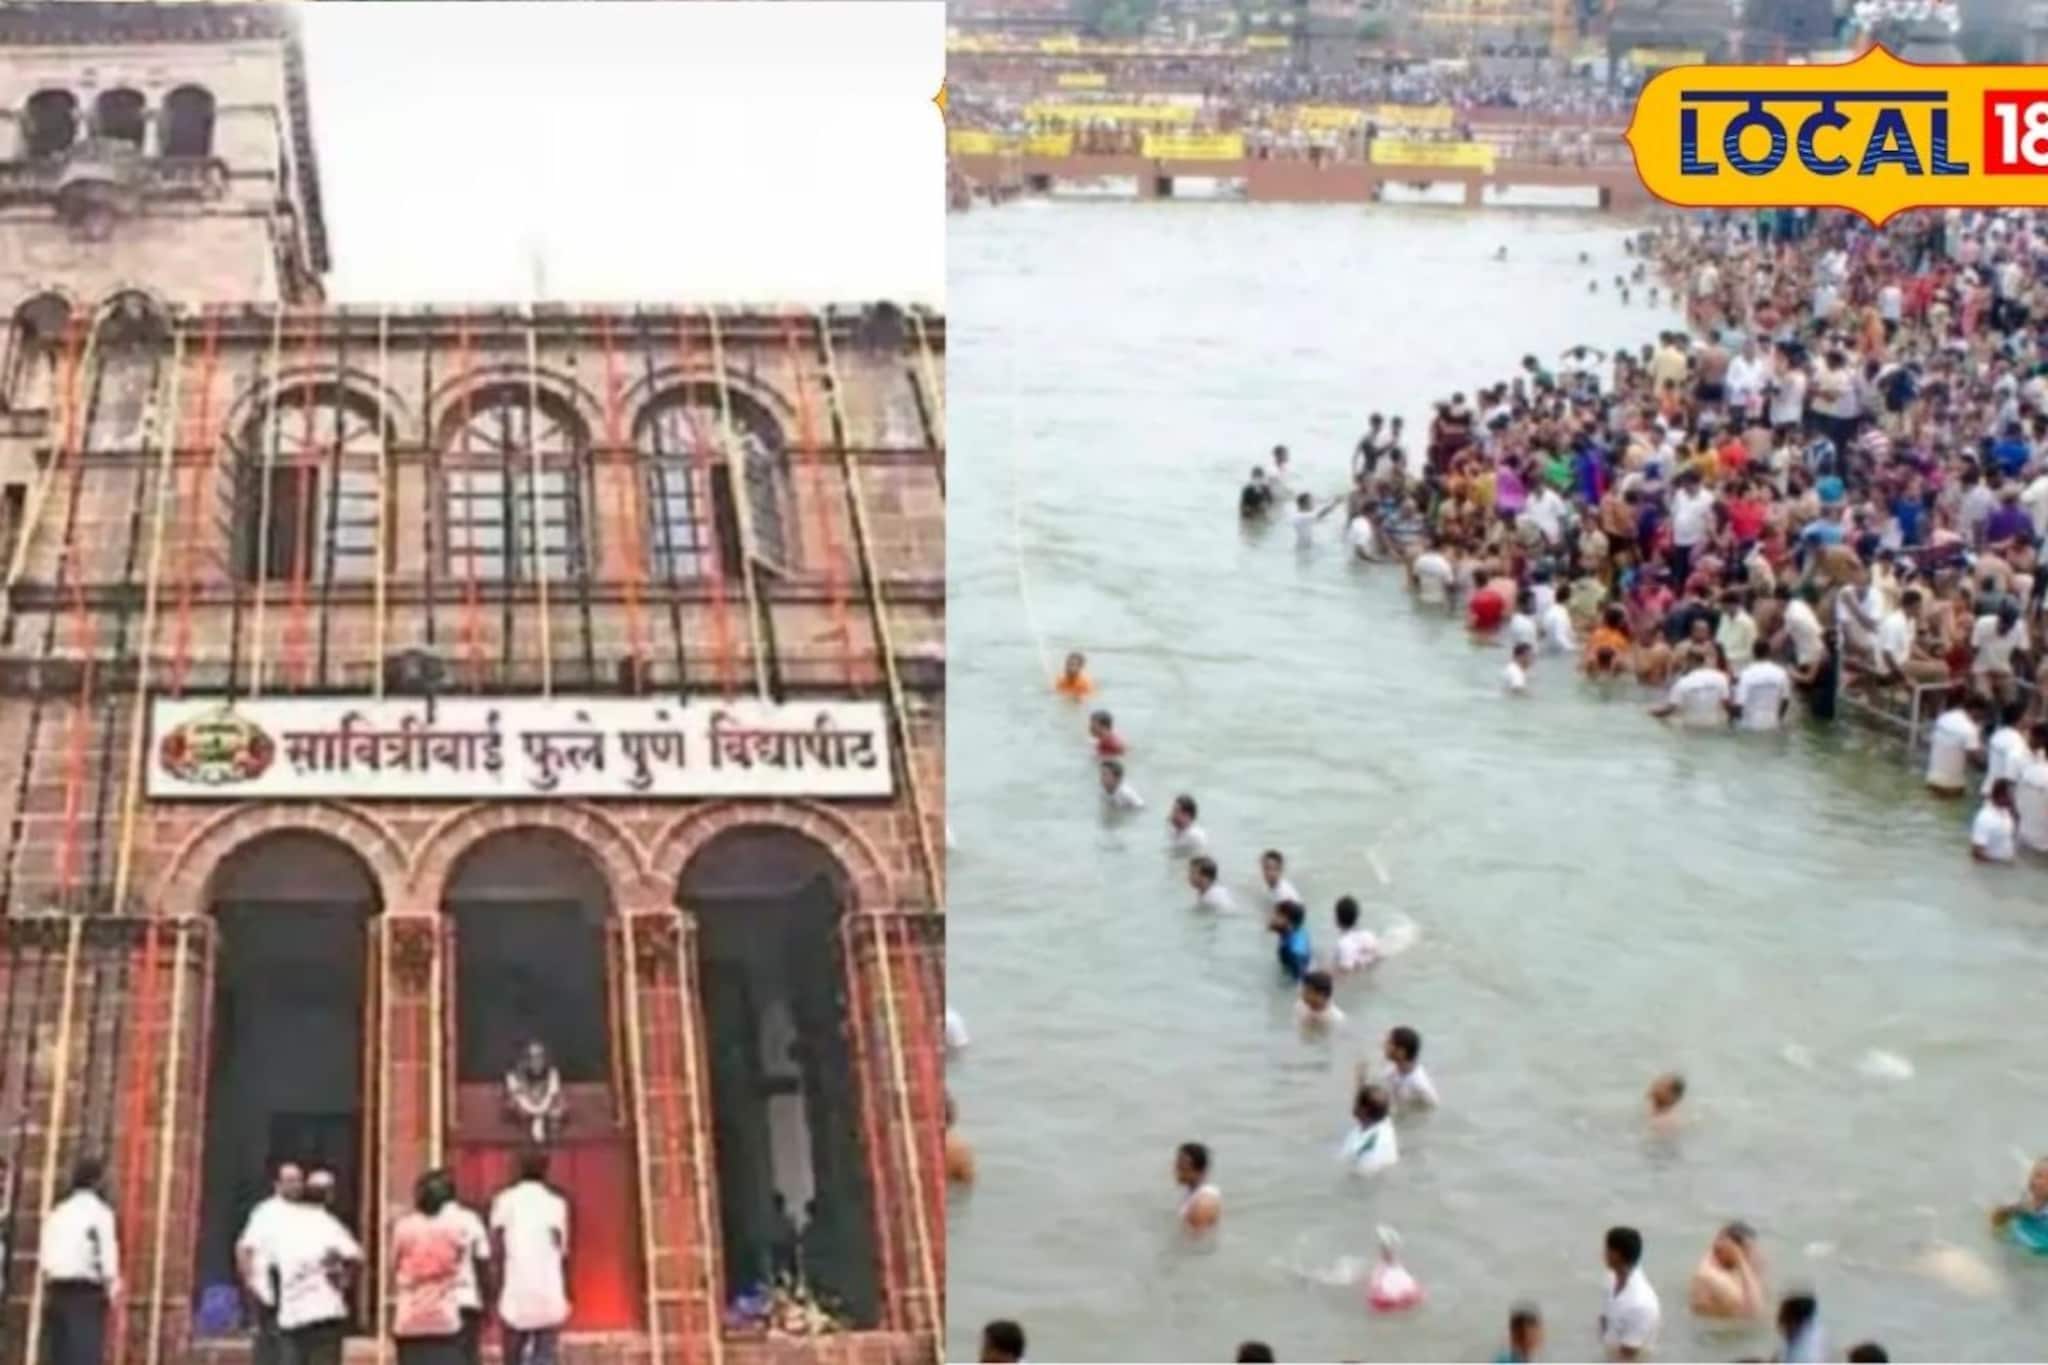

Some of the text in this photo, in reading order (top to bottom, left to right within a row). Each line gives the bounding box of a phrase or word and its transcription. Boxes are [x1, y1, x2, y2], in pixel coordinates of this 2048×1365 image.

[282, 709, 877, 790] सावित्रीबाई फुले पुणे विद्यापीठ
